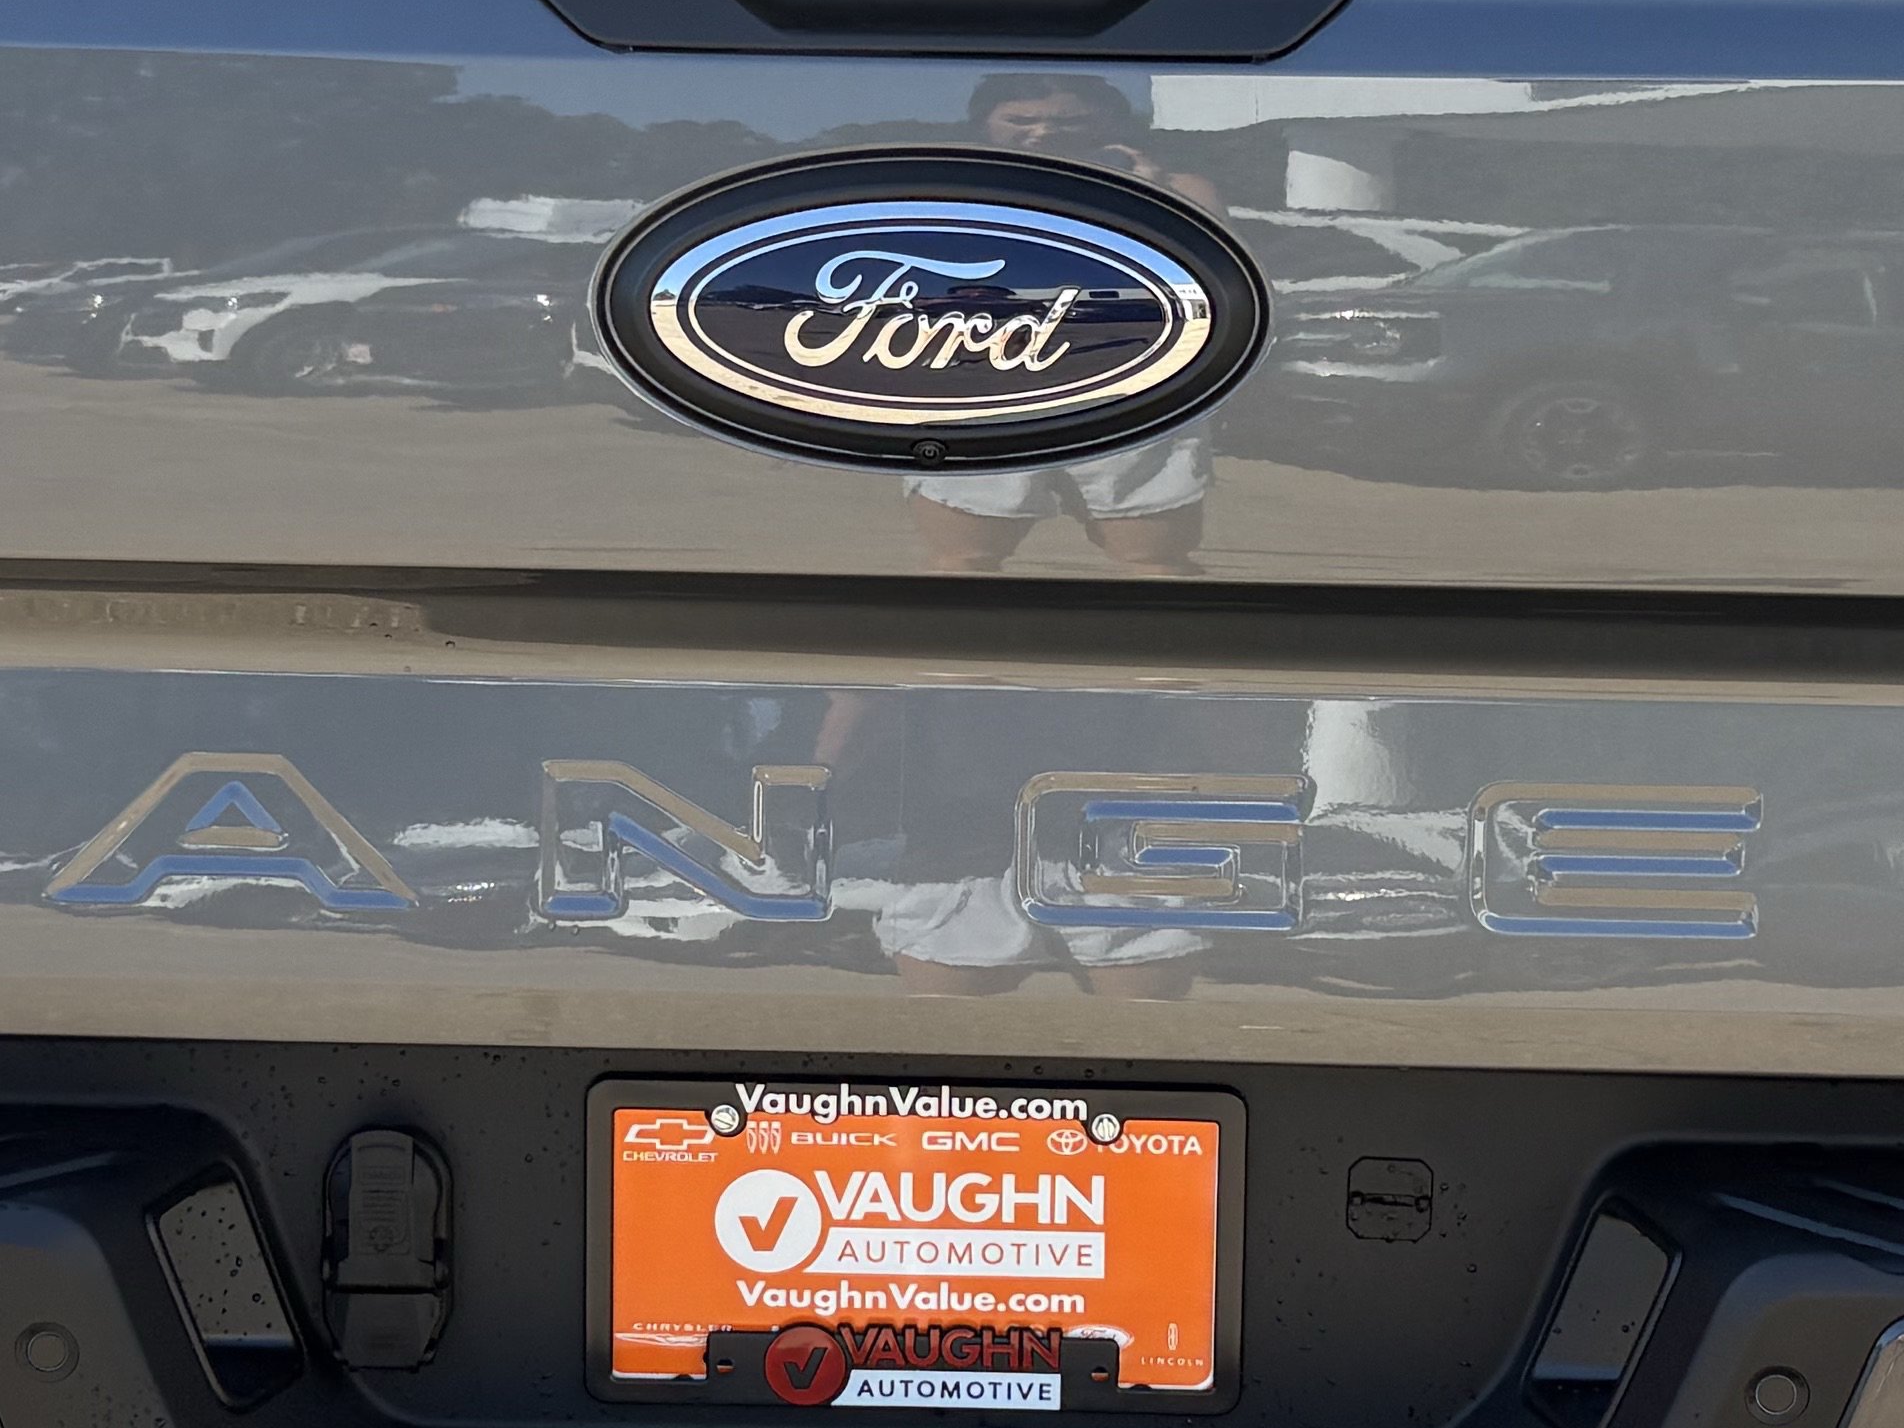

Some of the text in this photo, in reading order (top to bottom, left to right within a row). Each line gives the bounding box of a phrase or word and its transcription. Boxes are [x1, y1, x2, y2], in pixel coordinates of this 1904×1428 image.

[783, 249, 1081, 372] Ford
[735, 1083, 1088, 1125] VaughnValue.com
[791, 1131, 897, 1147] BUICK
[921, 1130, 1021, 1153] GMC
[622, 1151, 718, 1162] CHEVROLET
[814, 1171, 1104, 1225] VAUGHN
[838, 1240, 1093, 1268] AUTOMOTIVE
[736, 1279, 1086, 1317] VaughnValue.com
[838, 1326, 1063, 1371] VAUGHN
[1141, 1356, 1204, 1367] LINCOLN
[856, 1379, 1053, 1401] AUTOMOTIVE
